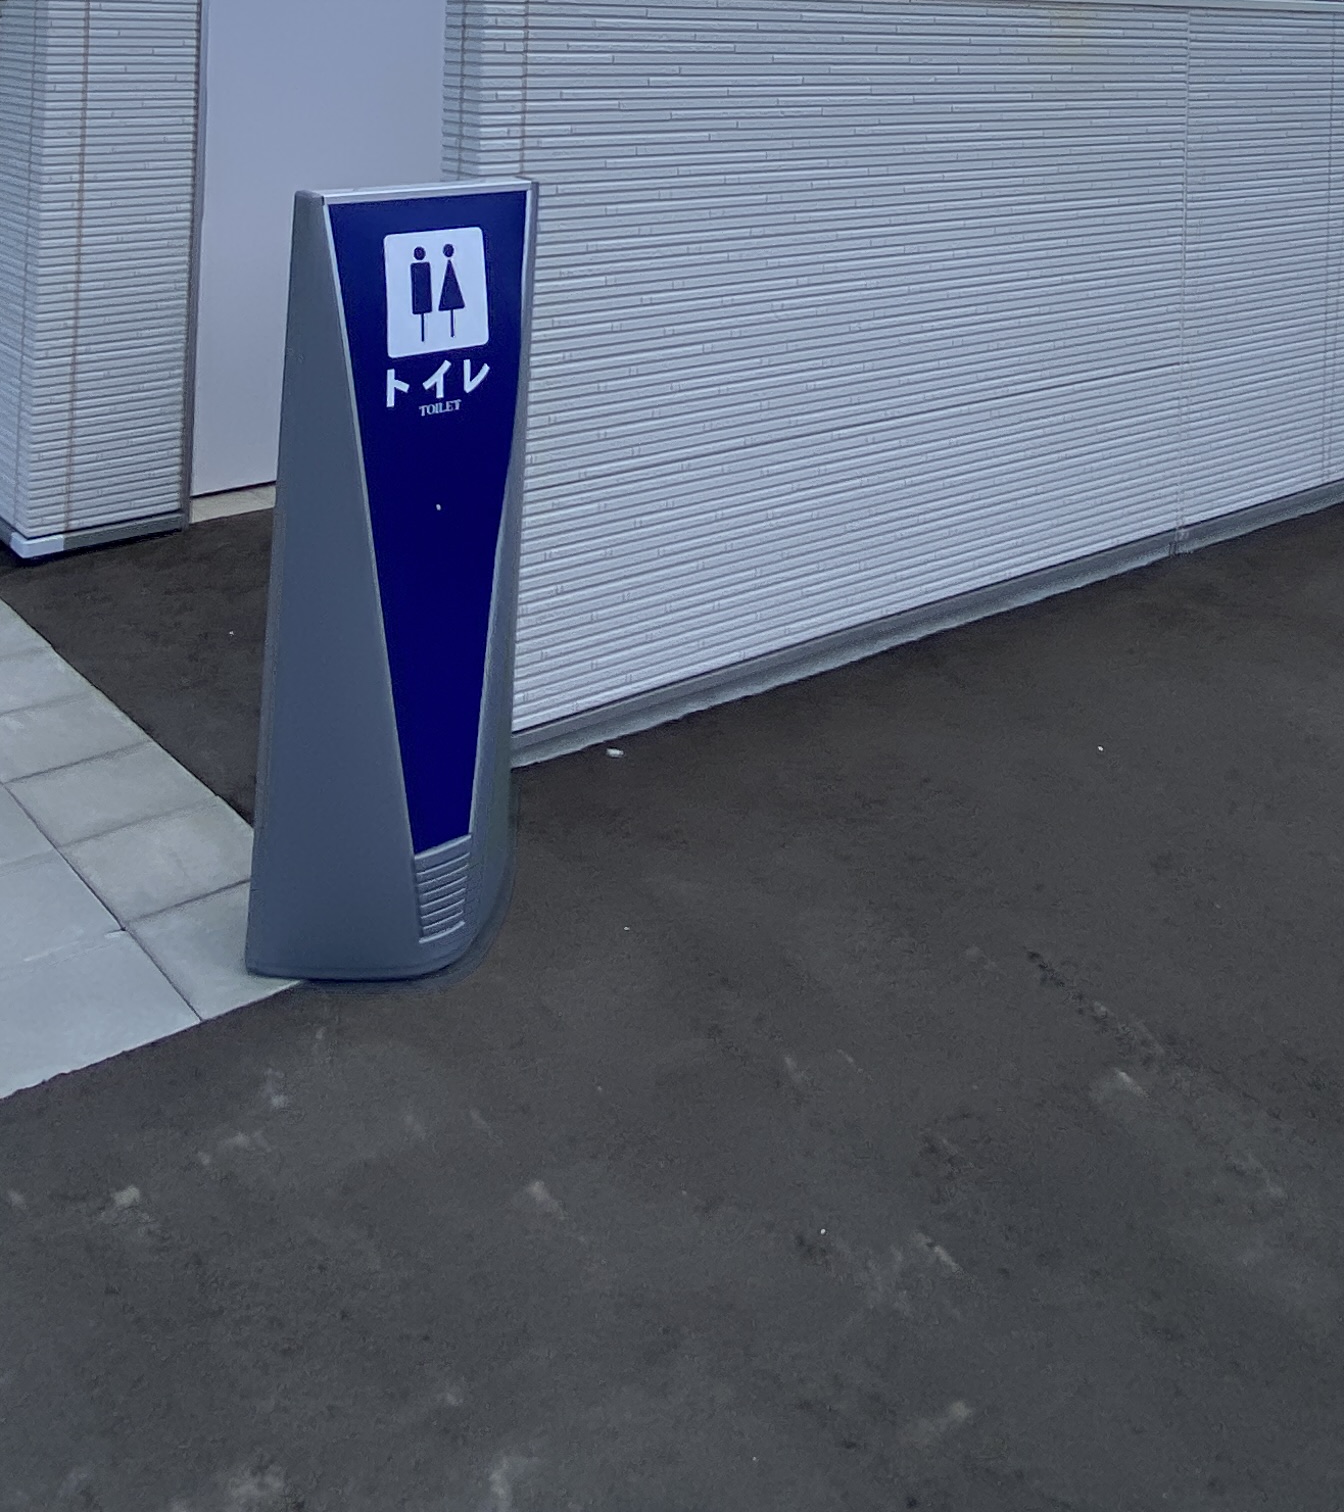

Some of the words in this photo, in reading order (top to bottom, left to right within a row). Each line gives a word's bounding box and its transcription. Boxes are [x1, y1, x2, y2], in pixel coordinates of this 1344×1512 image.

[386, 359, 490, 407] トイレ
[418, 399, 462, 416] TOILET
